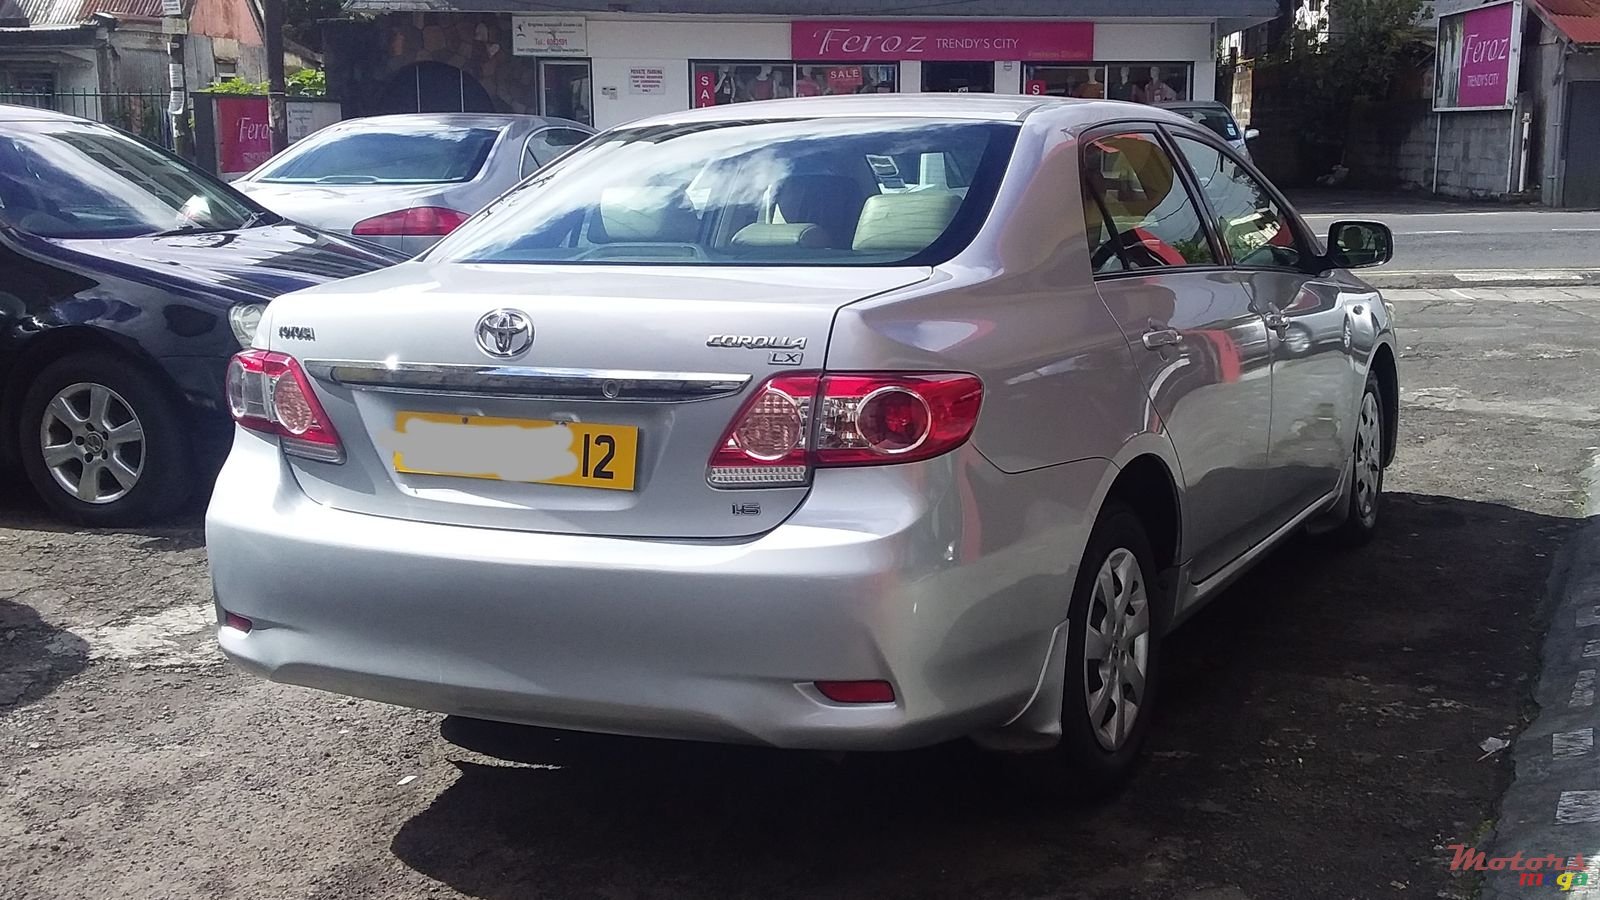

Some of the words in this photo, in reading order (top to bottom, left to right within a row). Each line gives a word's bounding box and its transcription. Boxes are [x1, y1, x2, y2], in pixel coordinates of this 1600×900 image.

[813, 28, 927, 55] Feroz
[935, 38, 990, 49] TRENDY'S
[993, 38, 1020, 49] CITY
[1463, 34, 1509, 67] Feroz
[830, 69, 860, 79] SALE
[706, 335, 808, 349] COROLLA
[771, 352, 801, 364] LX
[581, 433, 616, 480] 12
